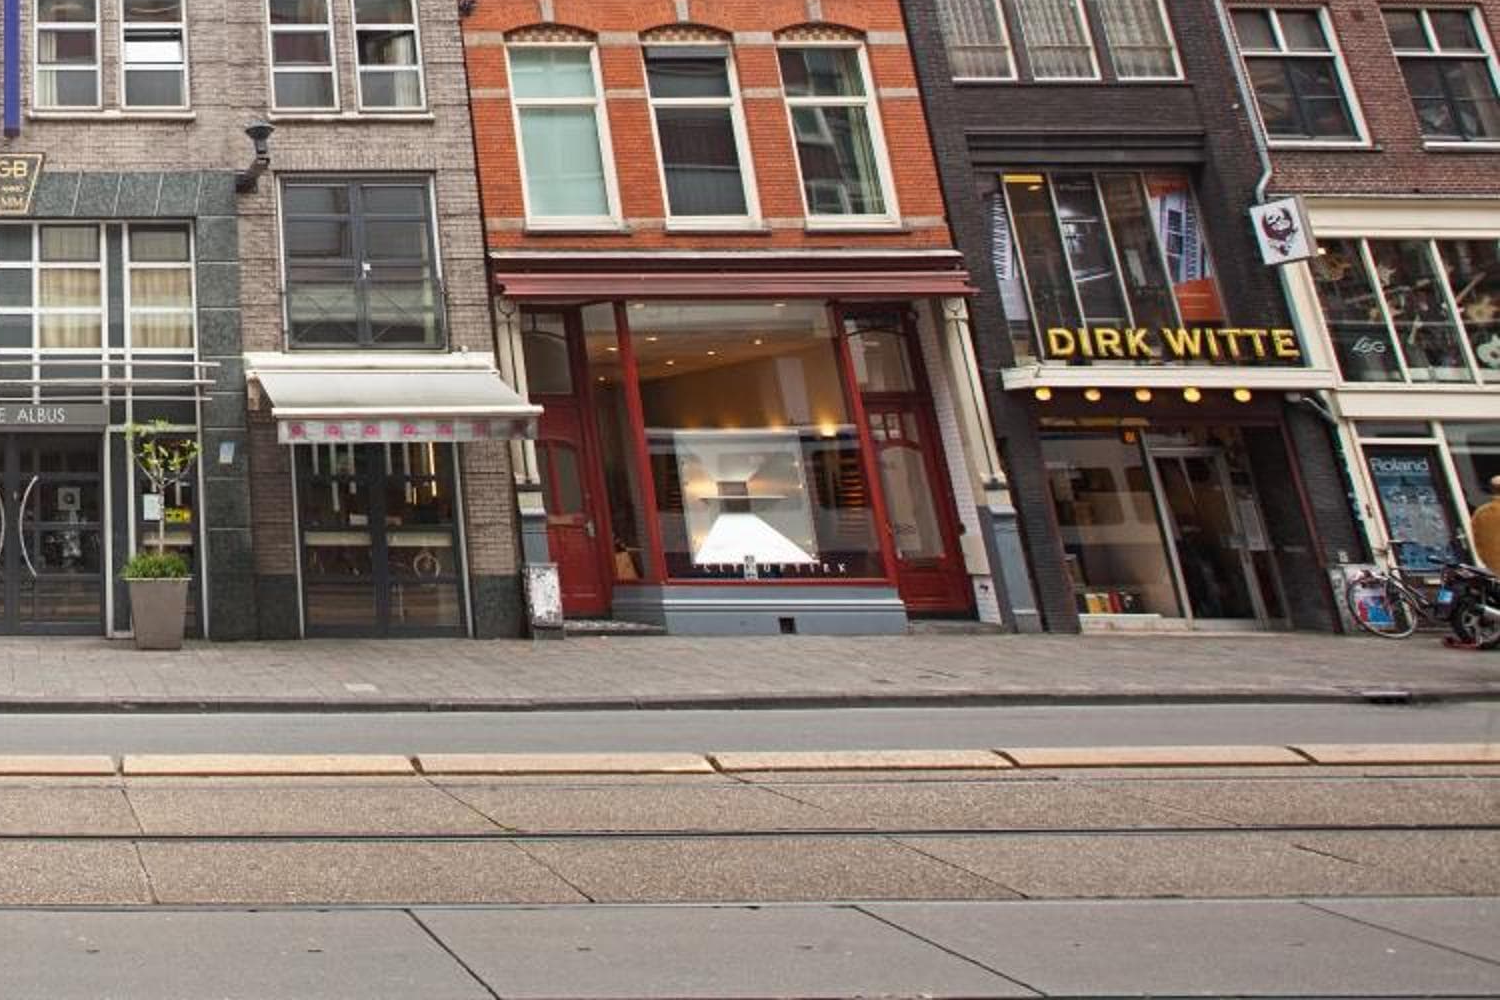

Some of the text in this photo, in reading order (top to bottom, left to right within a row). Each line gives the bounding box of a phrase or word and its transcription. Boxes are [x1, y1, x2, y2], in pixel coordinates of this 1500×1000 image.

[1047, 327, 1300, 358] DIRK WITTE
[17, 407, 66, 423] ALBUS
[1370, 457, 1429, 471] Roland
